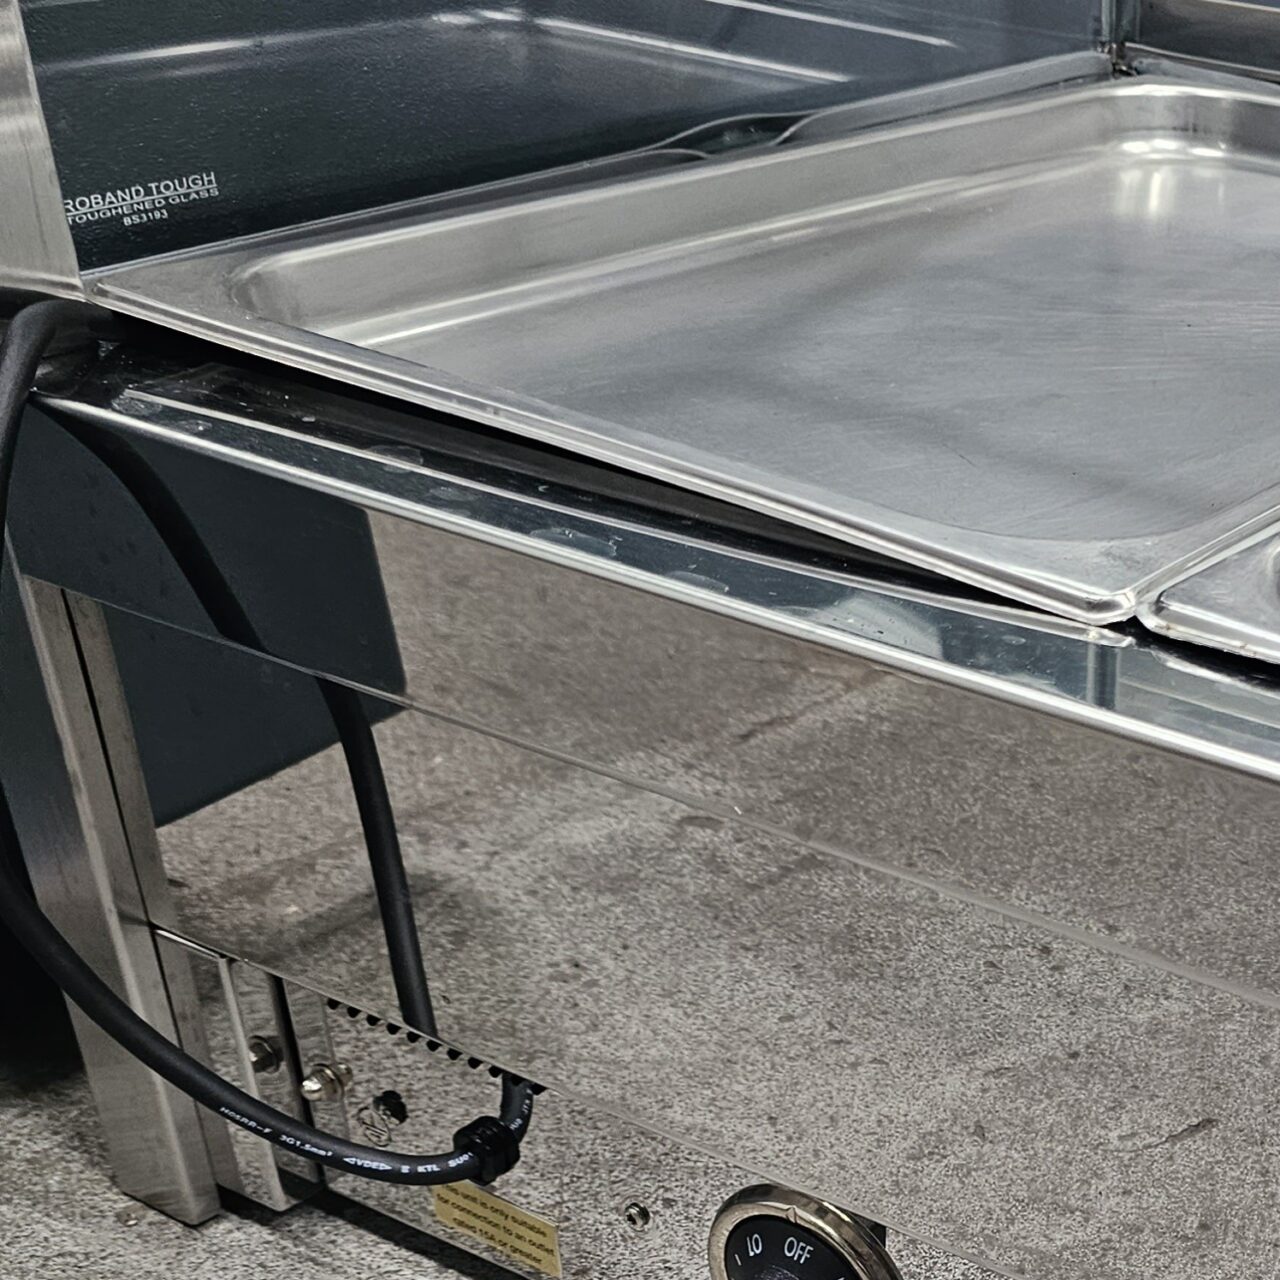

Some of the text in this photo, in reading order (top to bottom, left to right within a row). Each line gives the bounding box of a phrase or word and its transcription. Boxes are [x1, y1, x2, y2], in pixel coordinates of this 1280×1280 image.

[64, 171, 217, 213] ROBAND TOUGH
[67, 187, 220, 225] TOUGHENED GLASS
[123, 209, 169, 226] BS3193
[784, 1237, 814, 1264] OFF
